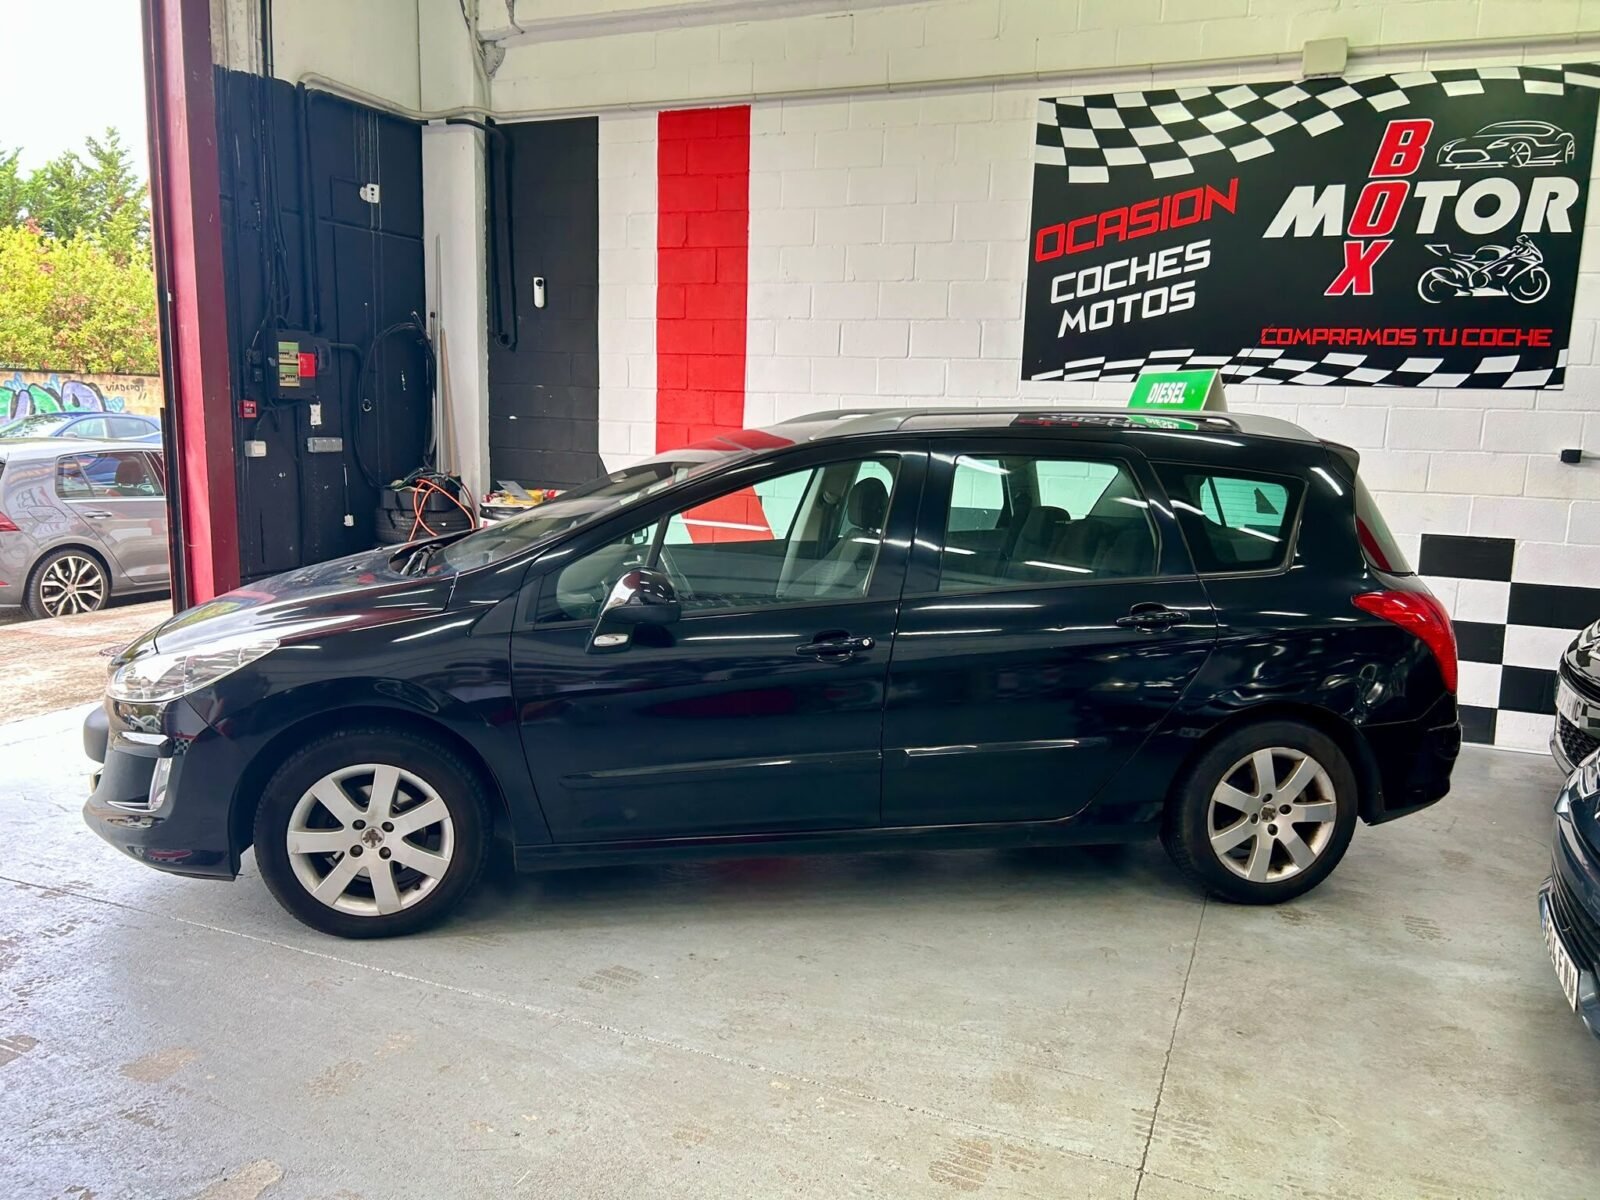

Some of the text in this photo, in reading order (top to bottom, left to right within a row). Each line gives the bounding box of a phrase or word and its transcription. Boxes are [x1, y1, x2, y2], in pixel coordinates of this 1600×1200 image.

[1035, 177, 1239, 263] OCASION
[1262, 176, 1580, 238] MOTOR
[1323, 118, 1434, 296] BOX
[1050, 238, 1212, 304] COCHES
[1057, 279, 1197, 339] MOTOS
[1260, 327, 1553, 348] COMPRAMOS TU COCHE
[1146, 381, 1188, 404] DIESEL
